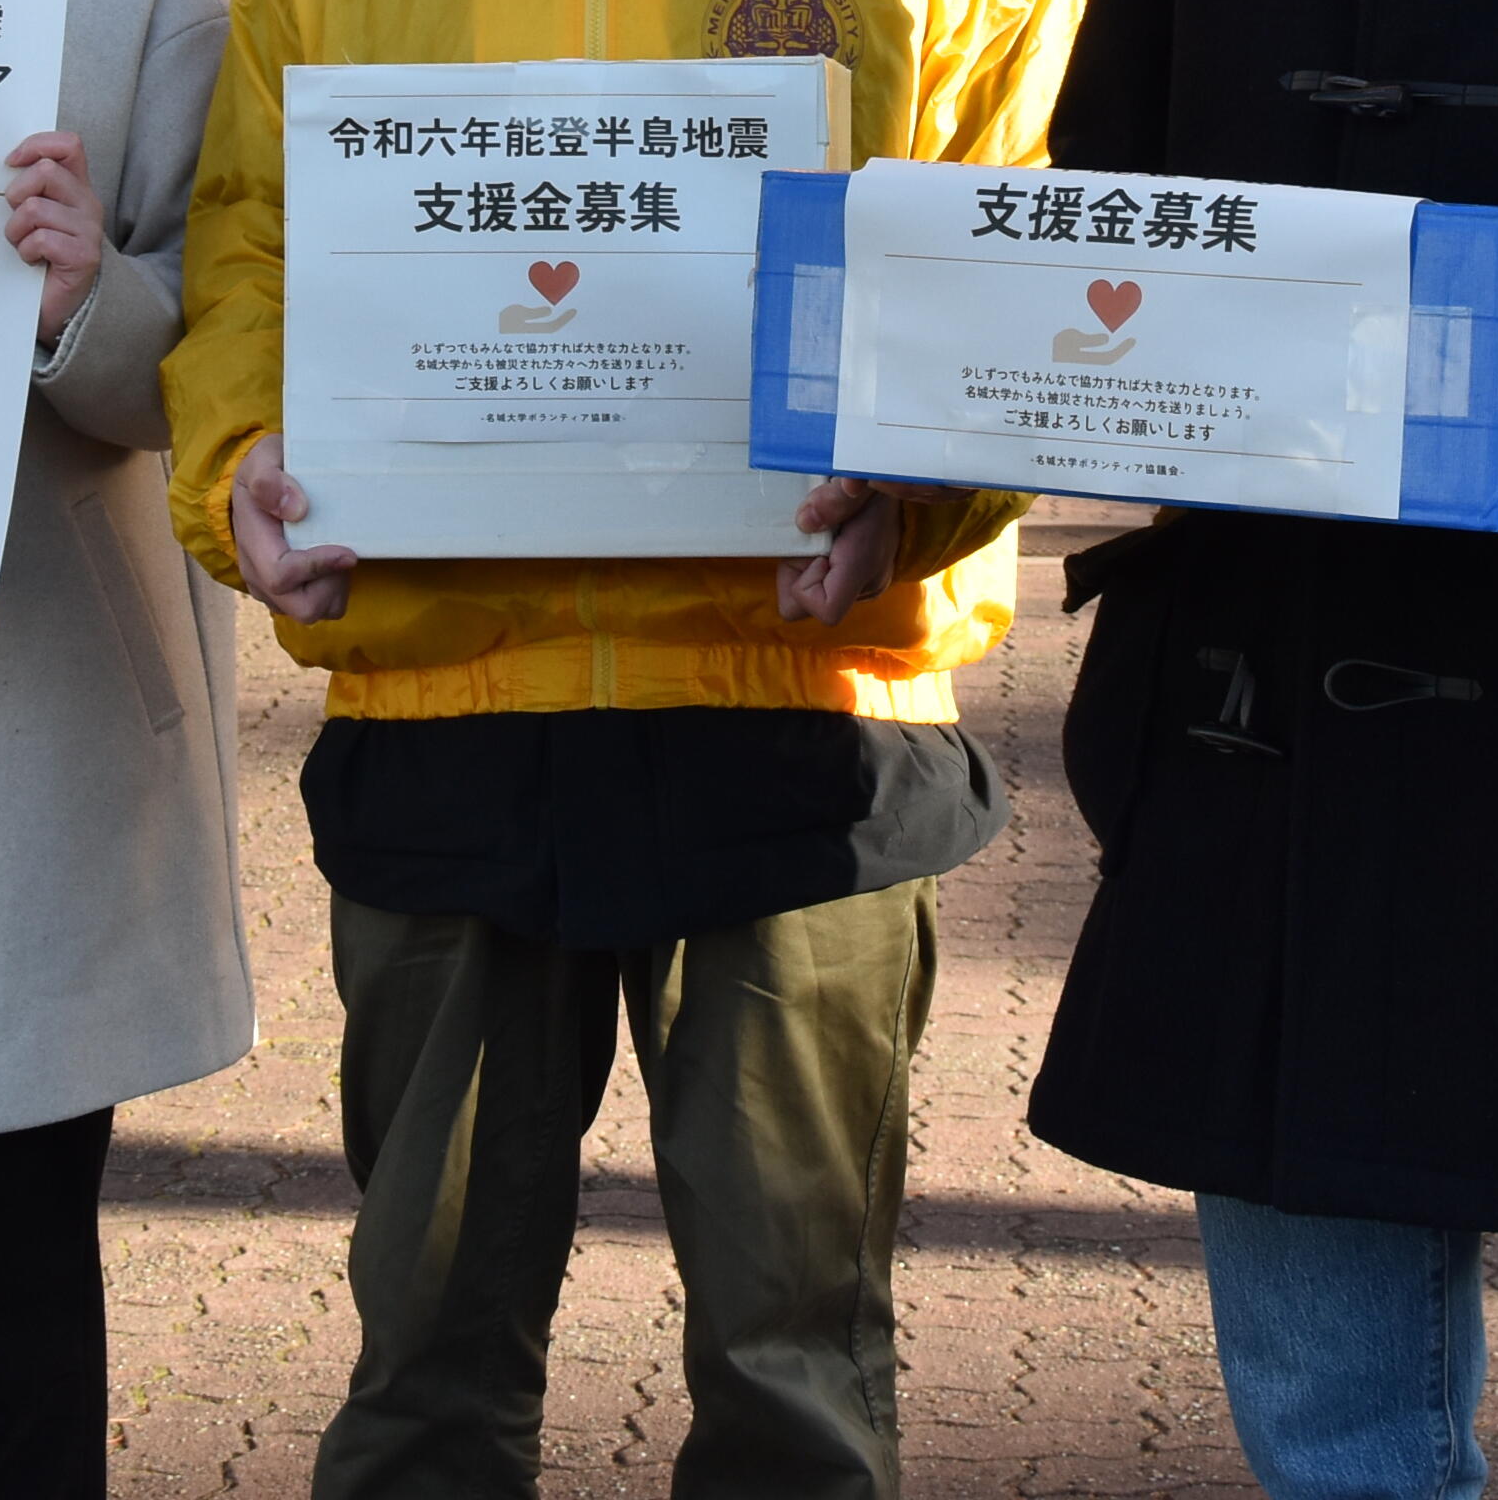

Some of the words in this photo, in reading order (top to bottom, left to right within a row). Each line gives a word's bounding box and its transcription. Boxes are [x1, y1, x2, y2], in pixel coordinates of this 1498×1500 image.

[328, 116, 768, 159] 令和六年能登半島地震
[414, 181, 680, 232] 支援金募集
[972, 182, 1258, 252] 支援金募集
[412, 343, 690, 356] 少しずつでもみんなで協力すれば大きな力となります。
[415, 358, 683, 370] 名城大学からも被災された方々へ力を送りましょう。
[455, 376, 653, 391] ご支援よろしくお願いします
[962, 366, 1259, 400] 少しずつでもみんなで協力すれば大きな力となります。
[965, 385, 1249, 419] 名城大学からも被災された方々へ力を送りましょう。
[1005, 410, 1215, 441] ご支援よろしくお願いします
